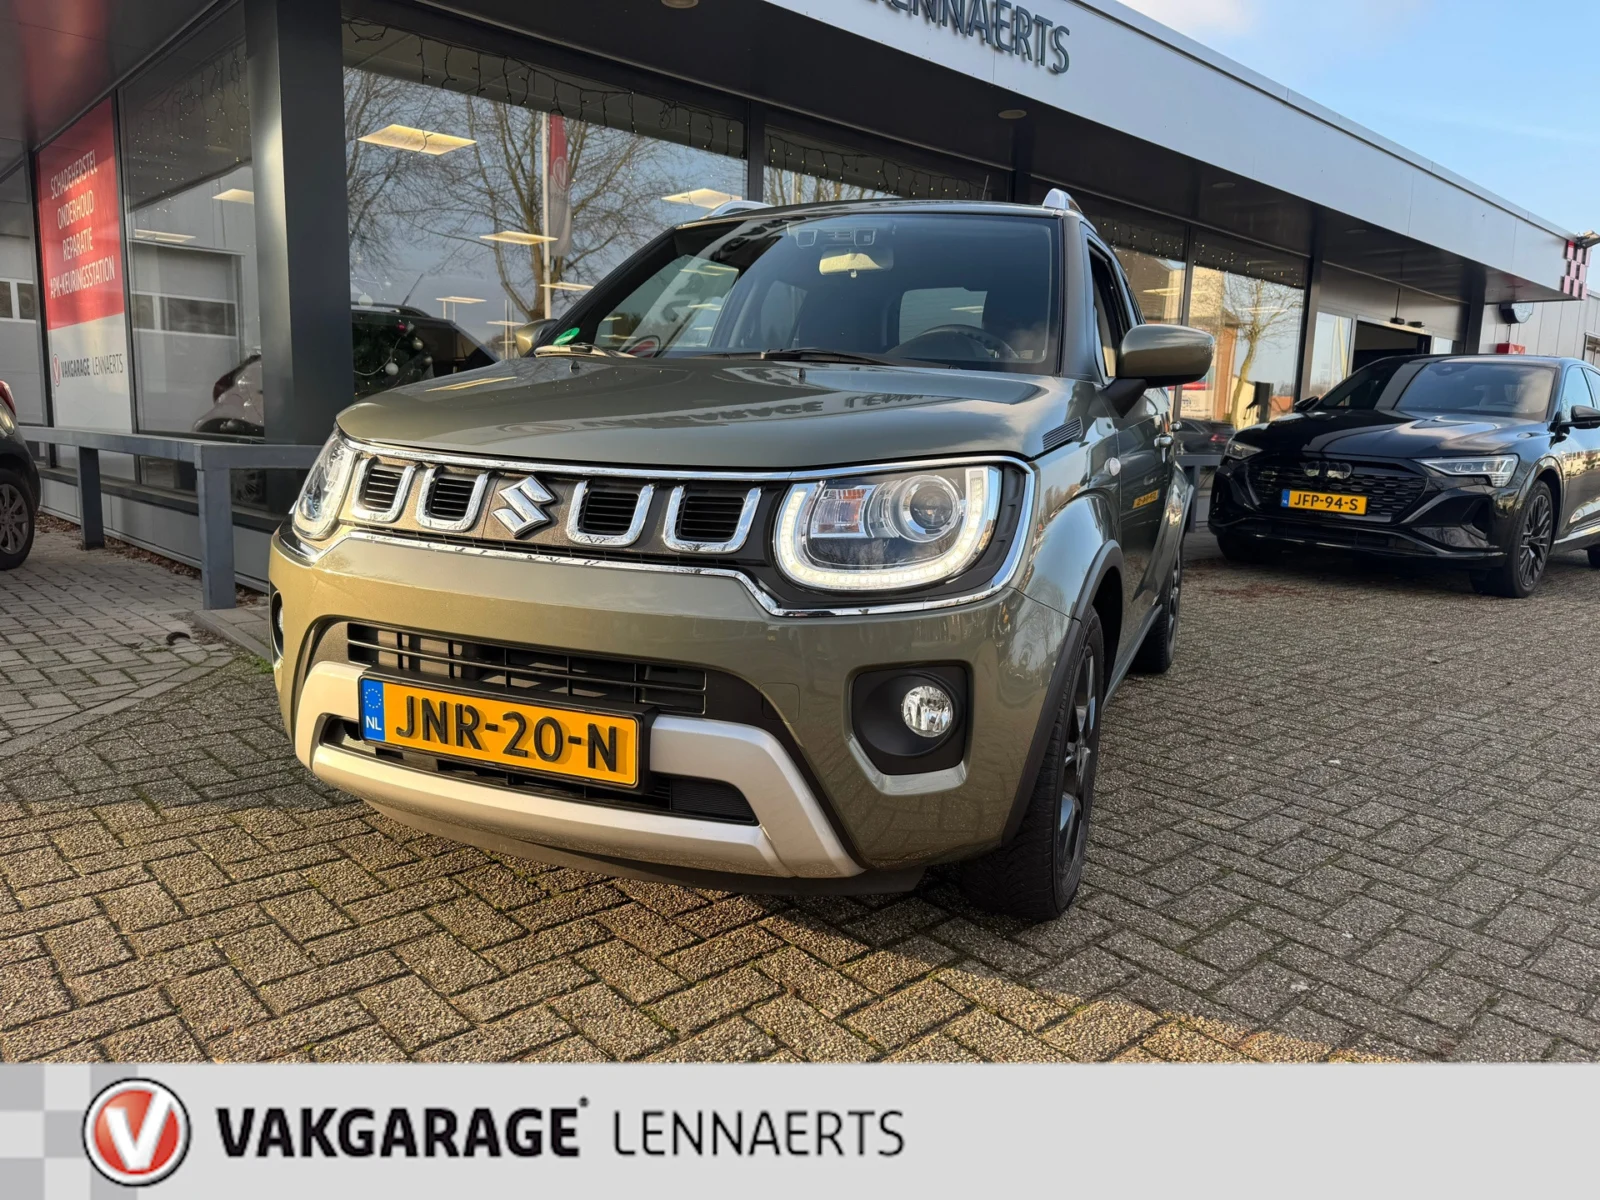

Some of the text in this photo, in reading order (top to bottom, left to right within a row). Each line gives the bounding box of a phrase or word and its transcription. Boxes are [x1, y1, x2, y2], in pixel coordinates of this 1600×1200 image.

[891, 0, 1070, 73] NAERTS
[51, 149, 98, 199] SCHADEHERSTEL
[57, 190, 94, 229] ONDERHOUD
[62, 227, 94, 262] REPARATIE
[50, 255, 116, 299] APK-KEURINGSSTATION
[61, 357, 90, 378] VAKGARAGE
[92, 353, 123, 376] LENNAERTS
[1294, 493, 1358, 511] JFP-94-S
[366, 695, 618, 772] NL JNR-20-N
